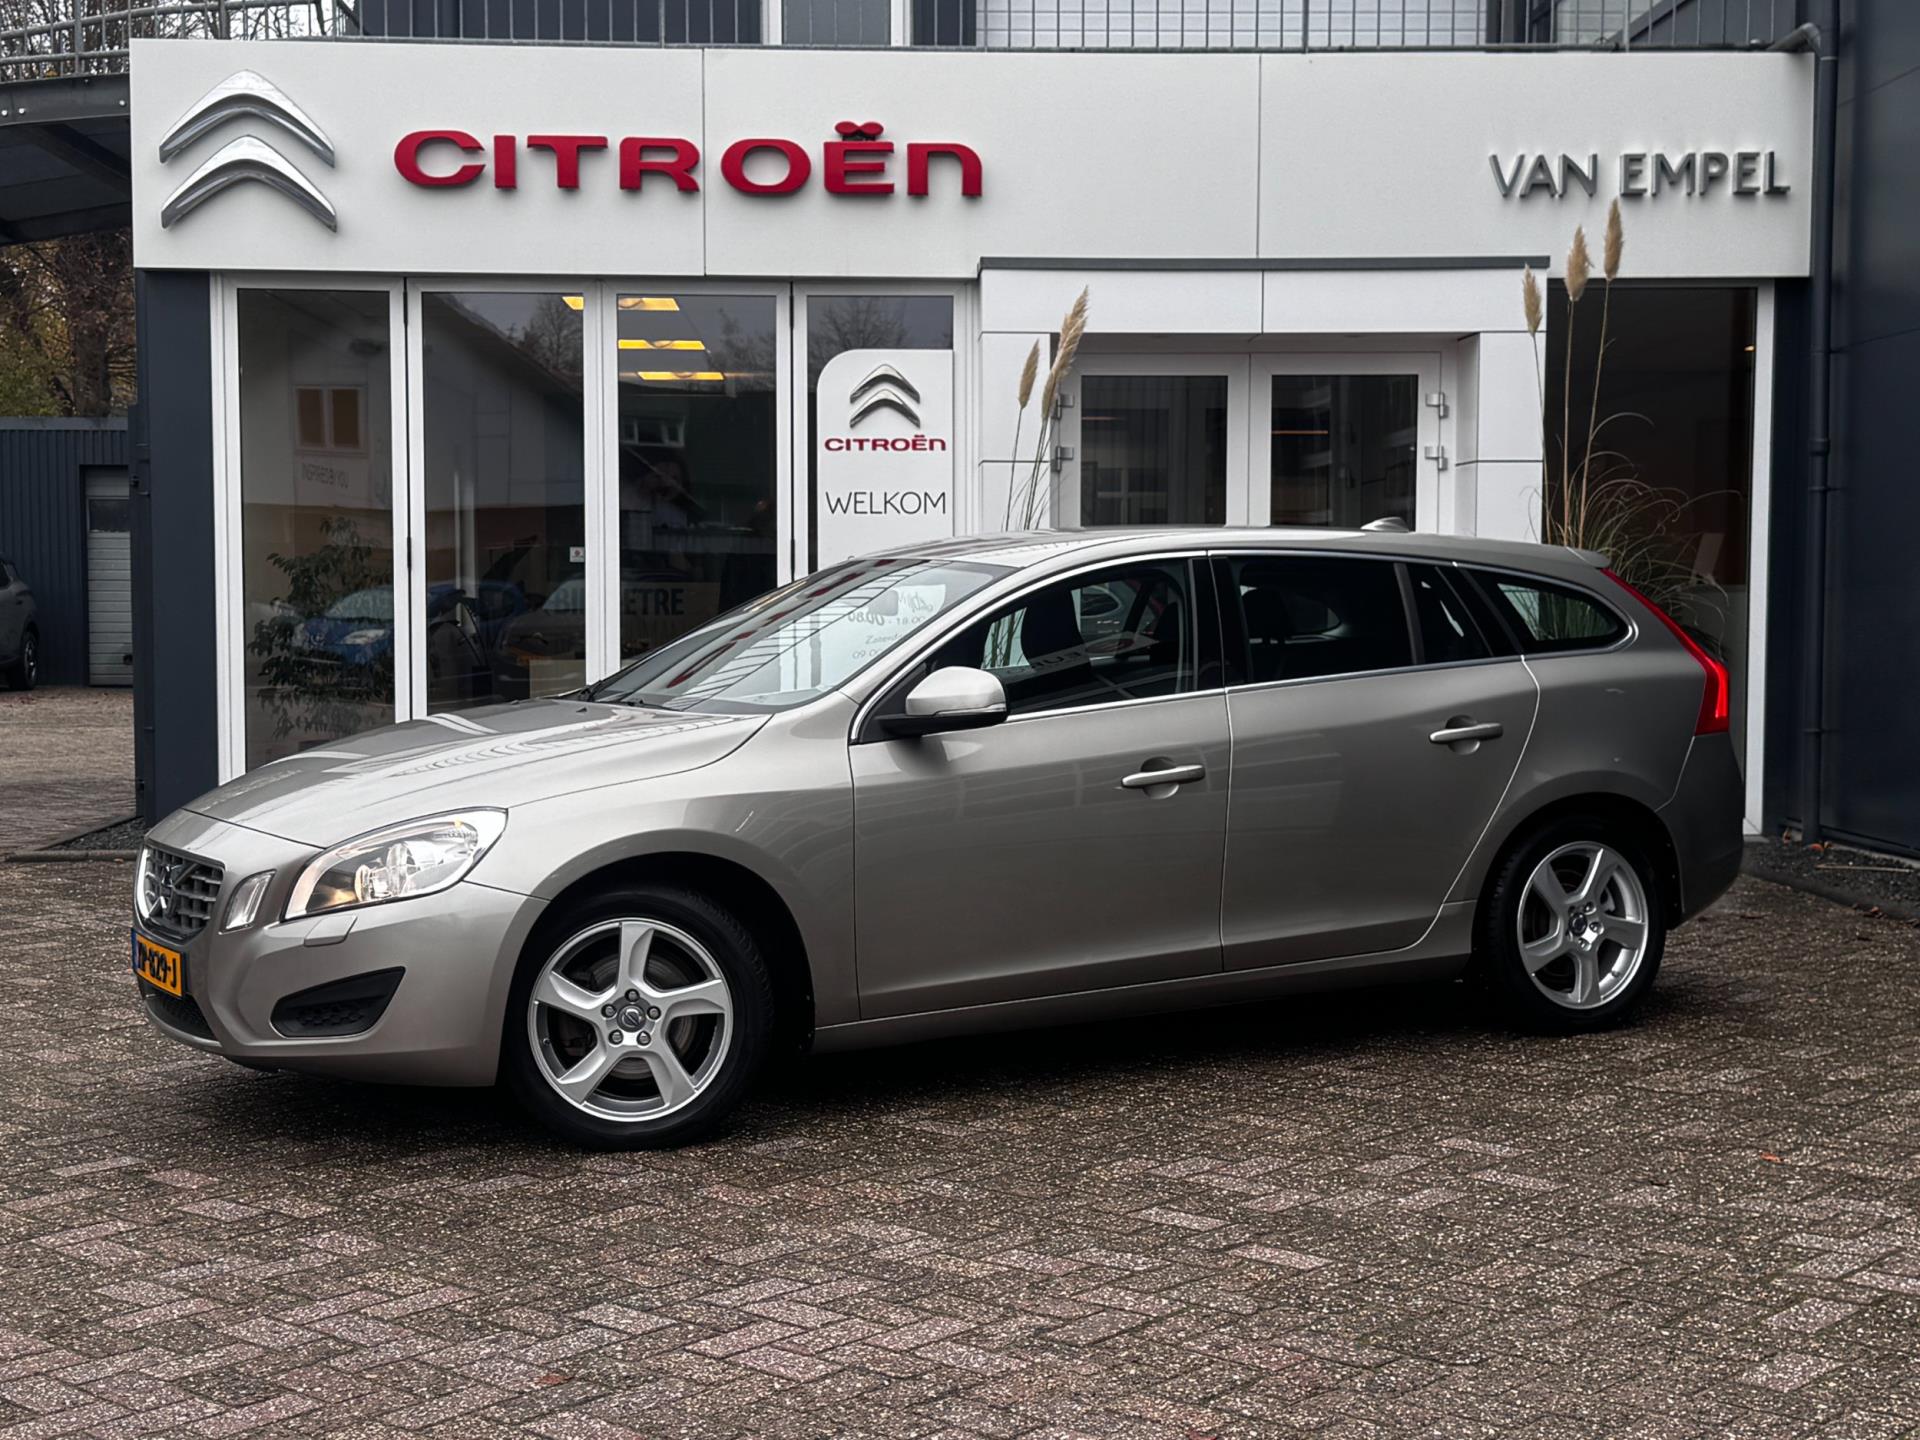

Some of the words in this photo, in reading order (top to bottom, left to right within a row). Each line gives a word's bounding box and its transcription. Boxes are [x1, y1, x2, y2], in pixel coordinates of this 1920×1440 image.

[394, 121, 982, 197] CITROËN
[1488, 153, 1598, 198] VAN
[1619, 151, 1791, 197] EMPEL
[824, 434, 947, 451] CITROËN
[825, 491, 946, 514] WELKOM
